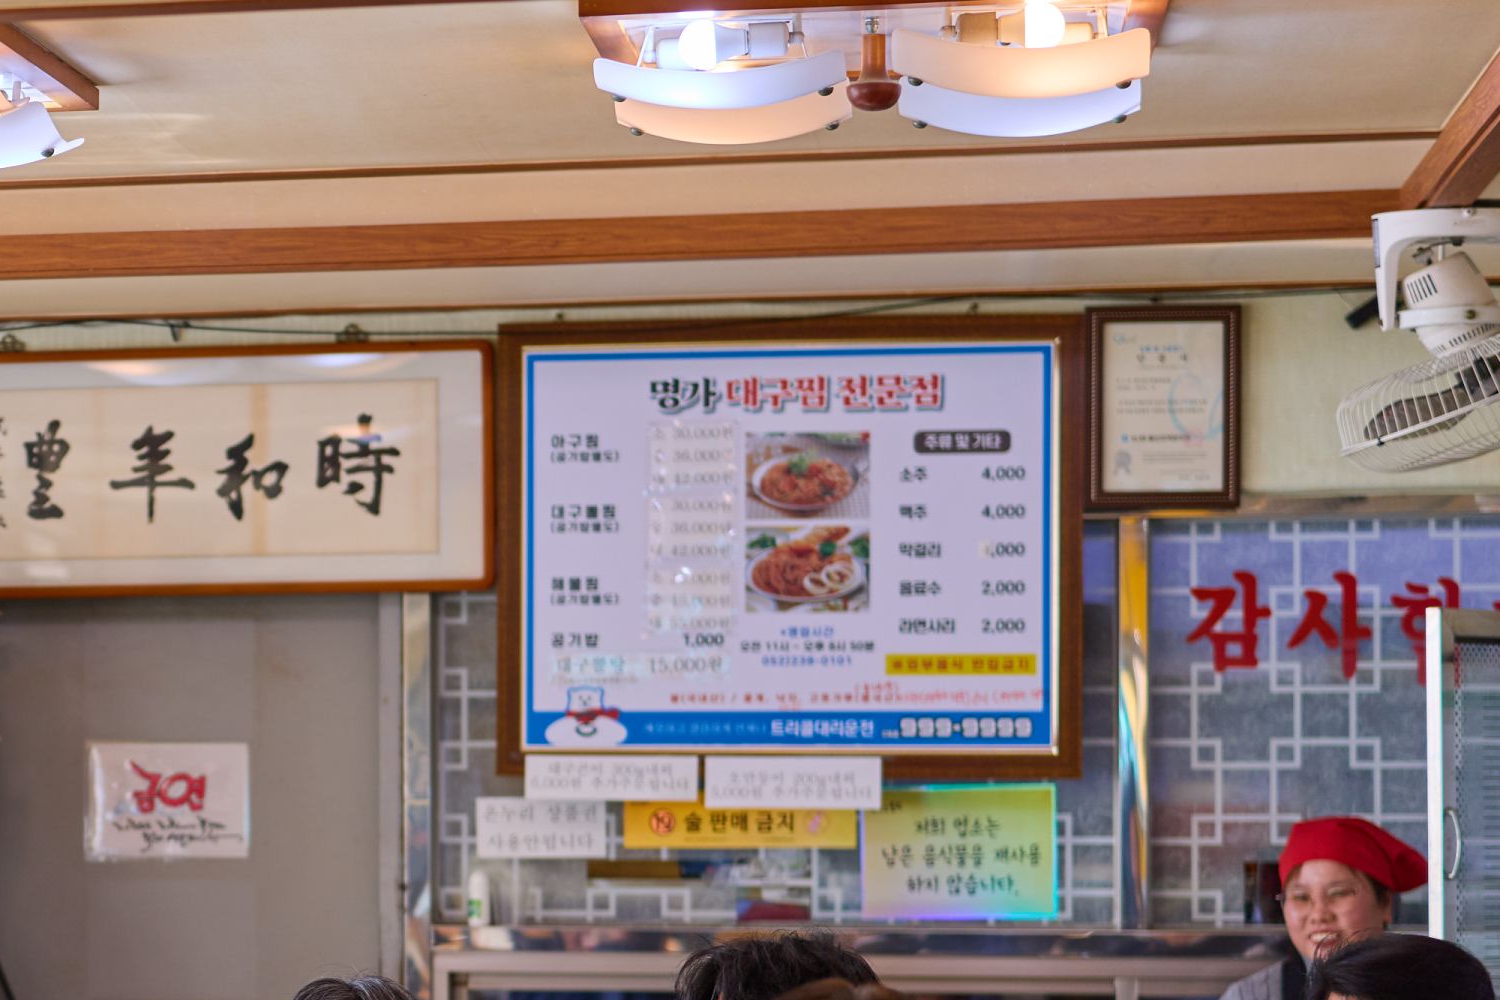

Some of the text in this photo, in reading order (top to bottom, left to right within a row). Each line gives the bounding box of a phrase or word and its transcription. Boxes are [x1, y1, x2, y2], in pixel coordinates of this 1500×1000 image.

[650, 372, 944, 415] 명가 대구찜 전문점
[972, 431, 1001, 449] 기타
[900, 466, 1026, 482] 소주 4,000
[981, 504, 1026, 520] 4,000
[981, 581, 1026, 596] 2,000
[981, 618, 1026, 634] 2,000
[683, 632, 724, 648] 1,000
[684, 811, 703, 834] 술
[709, 810, 749, 834] 판매
[756, 810, 795, 834] 금지
[915, 815, 1002, 838] 저희 업소는
[881, 844, 1041, 868] 남은 음식물을 재사용
[907, 875, 1019, 897] 하지 않습니다.
